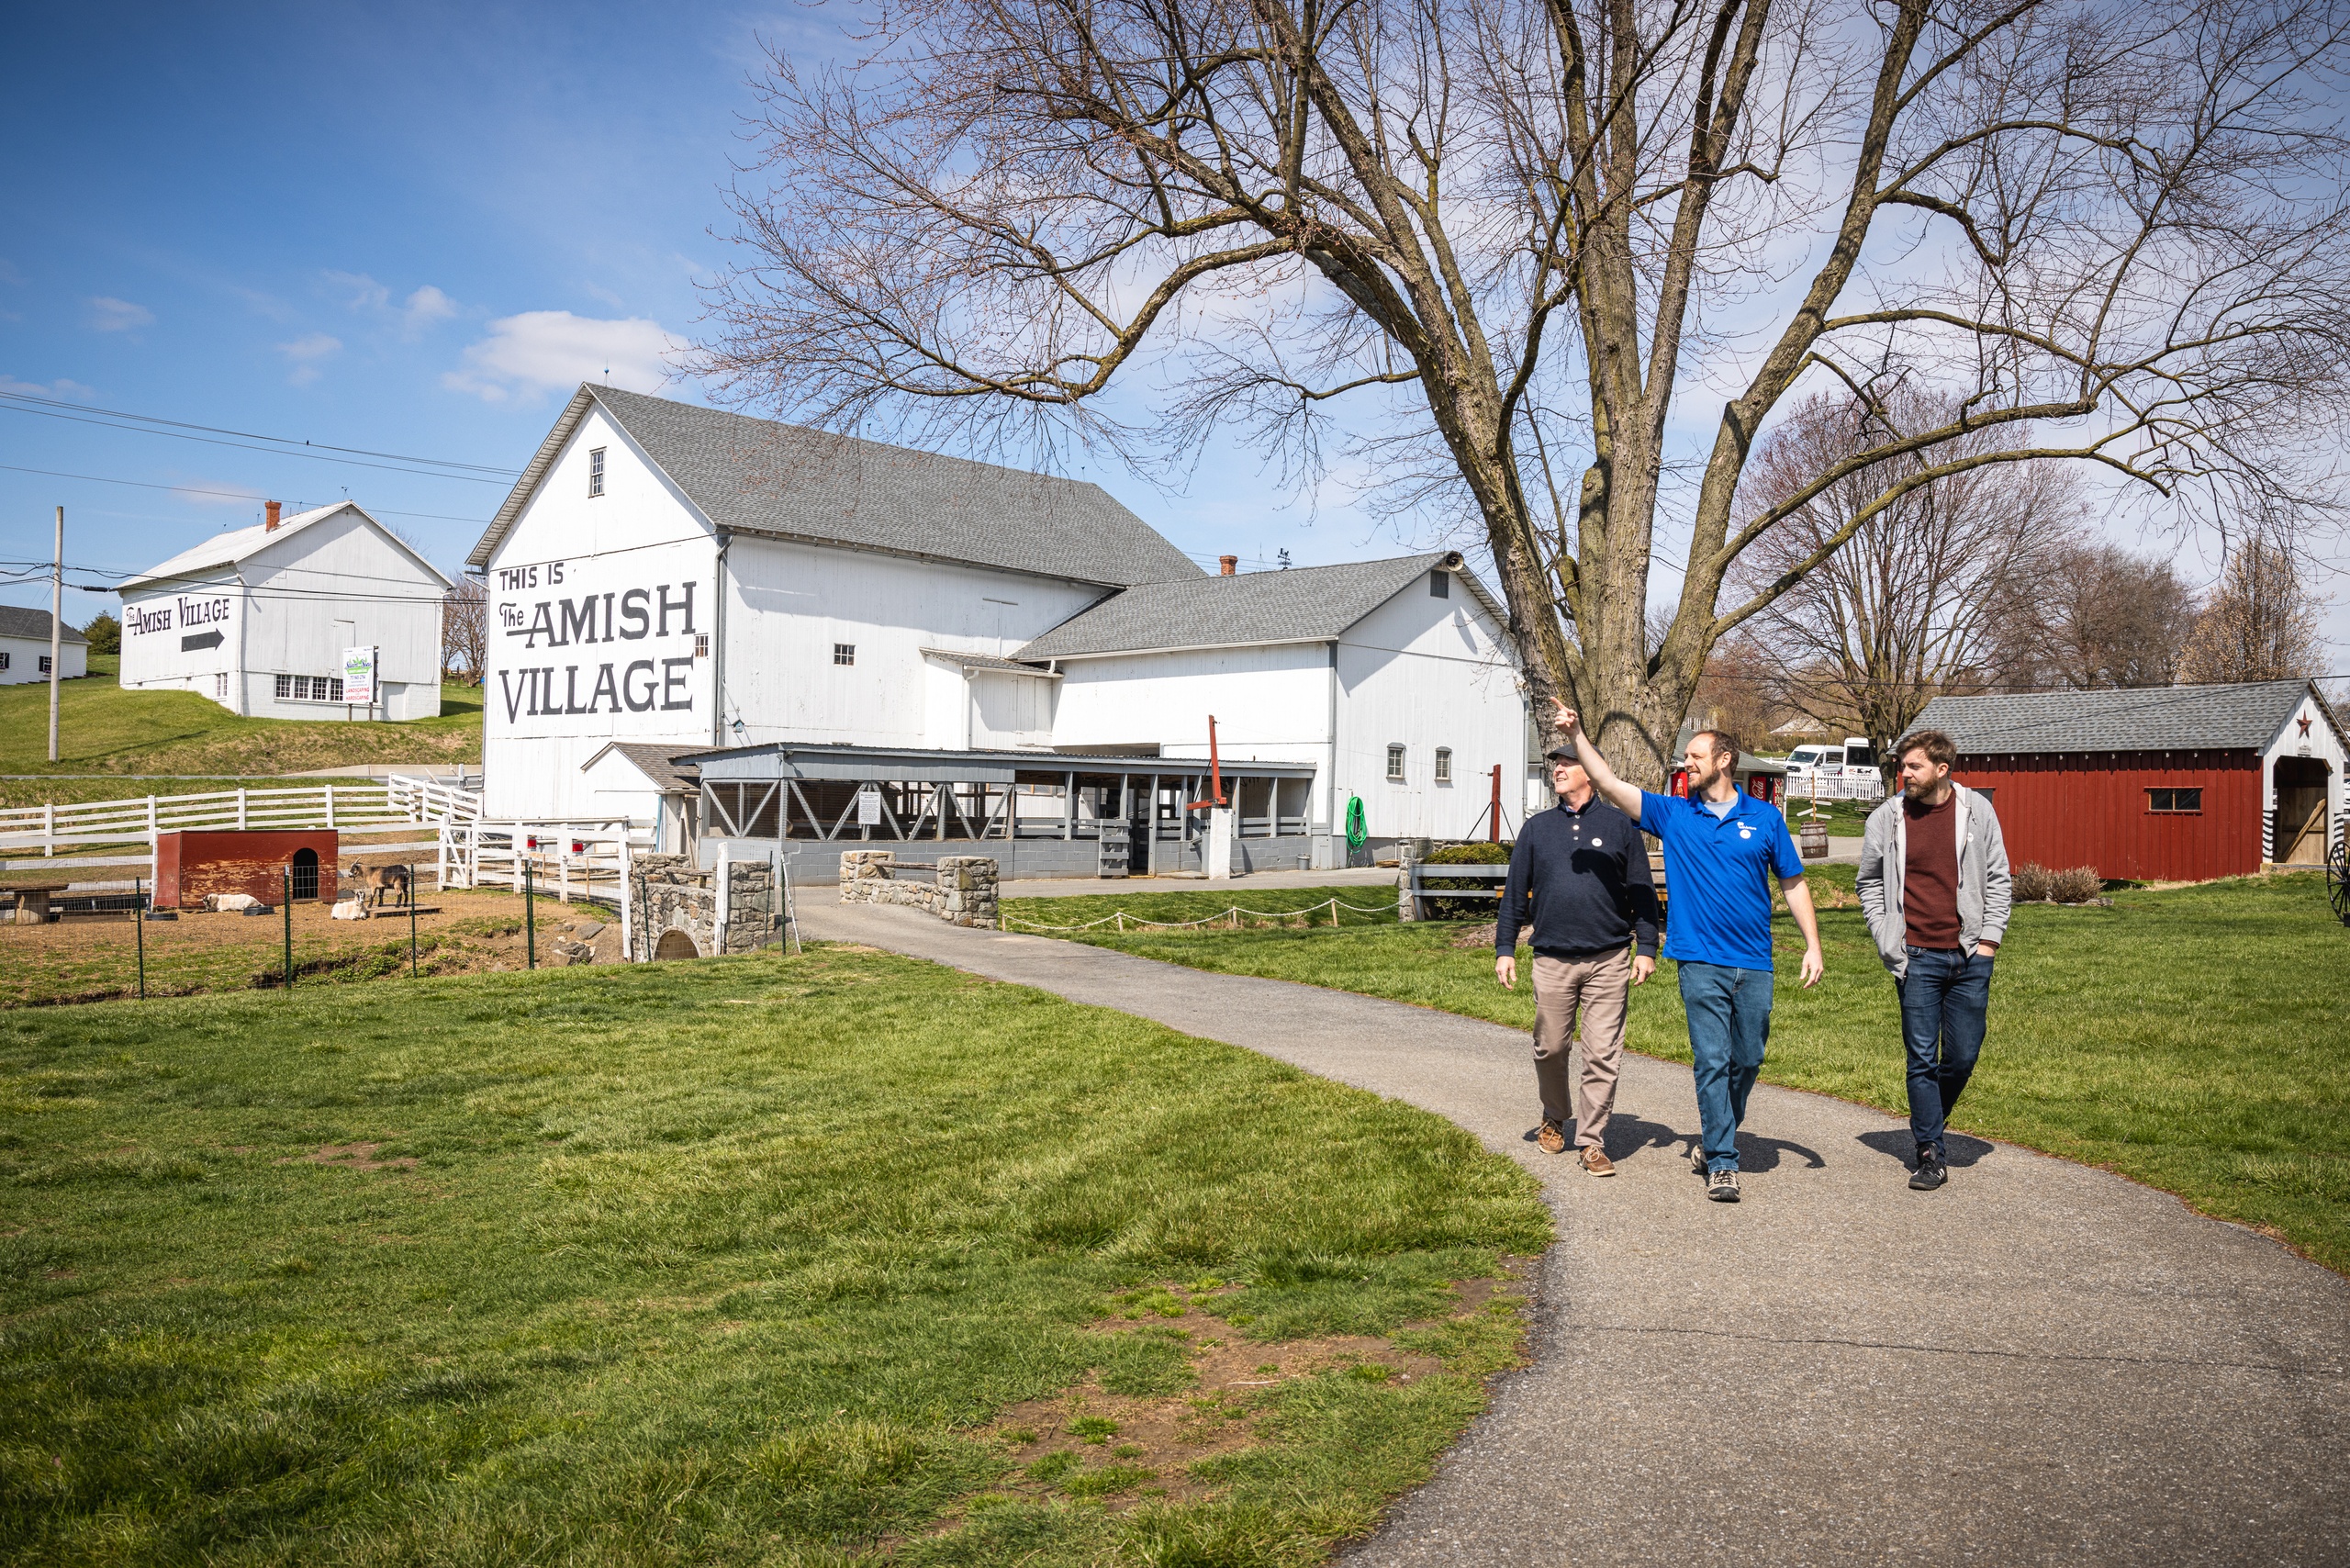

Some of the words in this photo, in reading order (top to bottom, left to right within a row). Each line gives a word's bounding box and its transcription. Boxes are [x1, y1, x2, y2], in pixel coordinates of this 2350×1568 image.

[499, 566, 537, 590] THIS
[548, 562, 564, 585] IS
[128, 607, 172, 635] AMISH
[178, 597, 229, 628] VILLAGE
[499, 602, 524, 627] The
[507, 581, 697, 648] AMISH
[498, 653, 694, 723] VILLAGE
